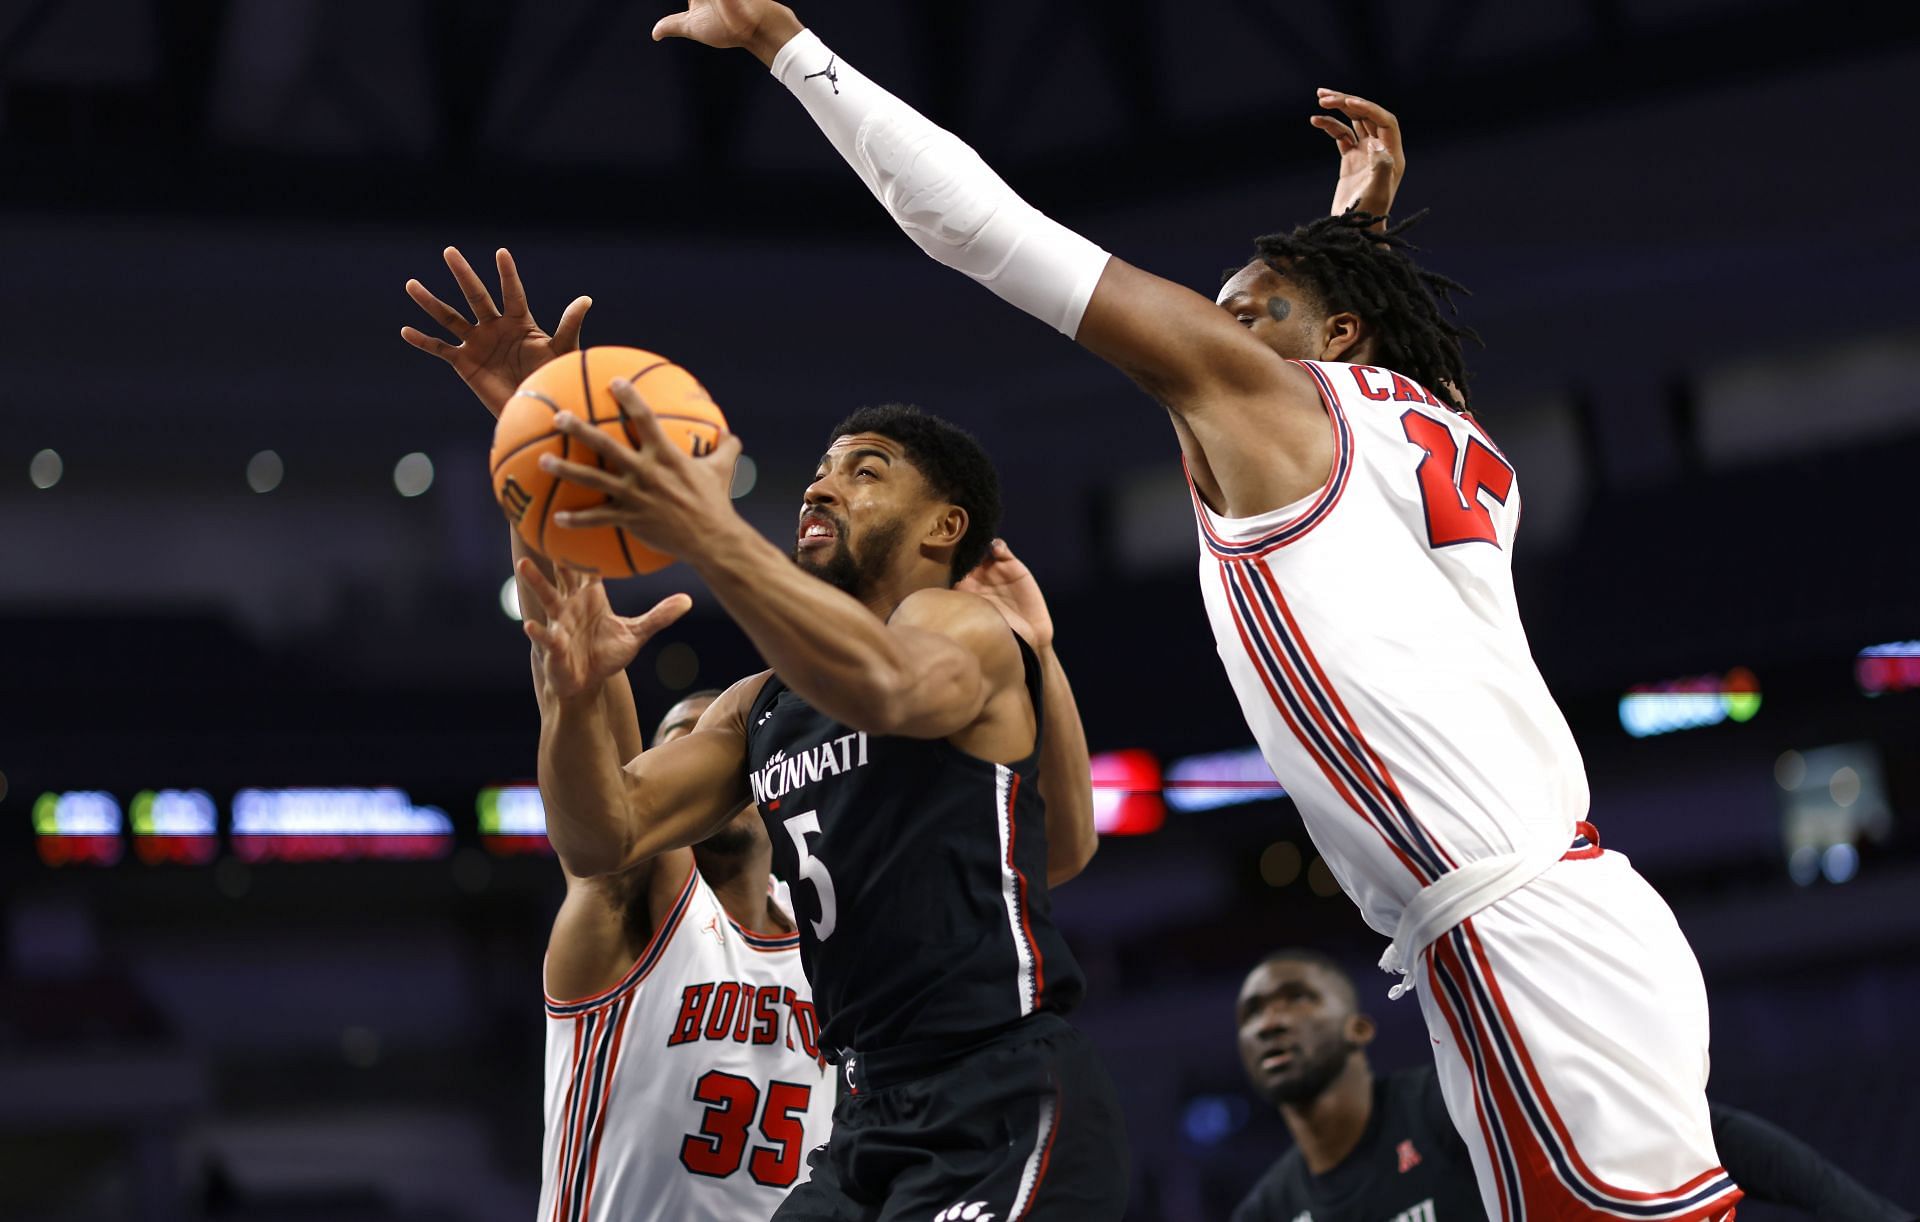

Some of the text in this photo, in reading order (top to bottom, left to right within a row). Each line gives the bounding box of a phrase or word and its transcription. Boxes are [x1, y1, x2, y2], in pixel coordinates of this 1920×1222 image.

[1348, 365, 1442, 409] CA
[783, 809, 837, 942] 5
[679, 1069, 812, 1189] 35
